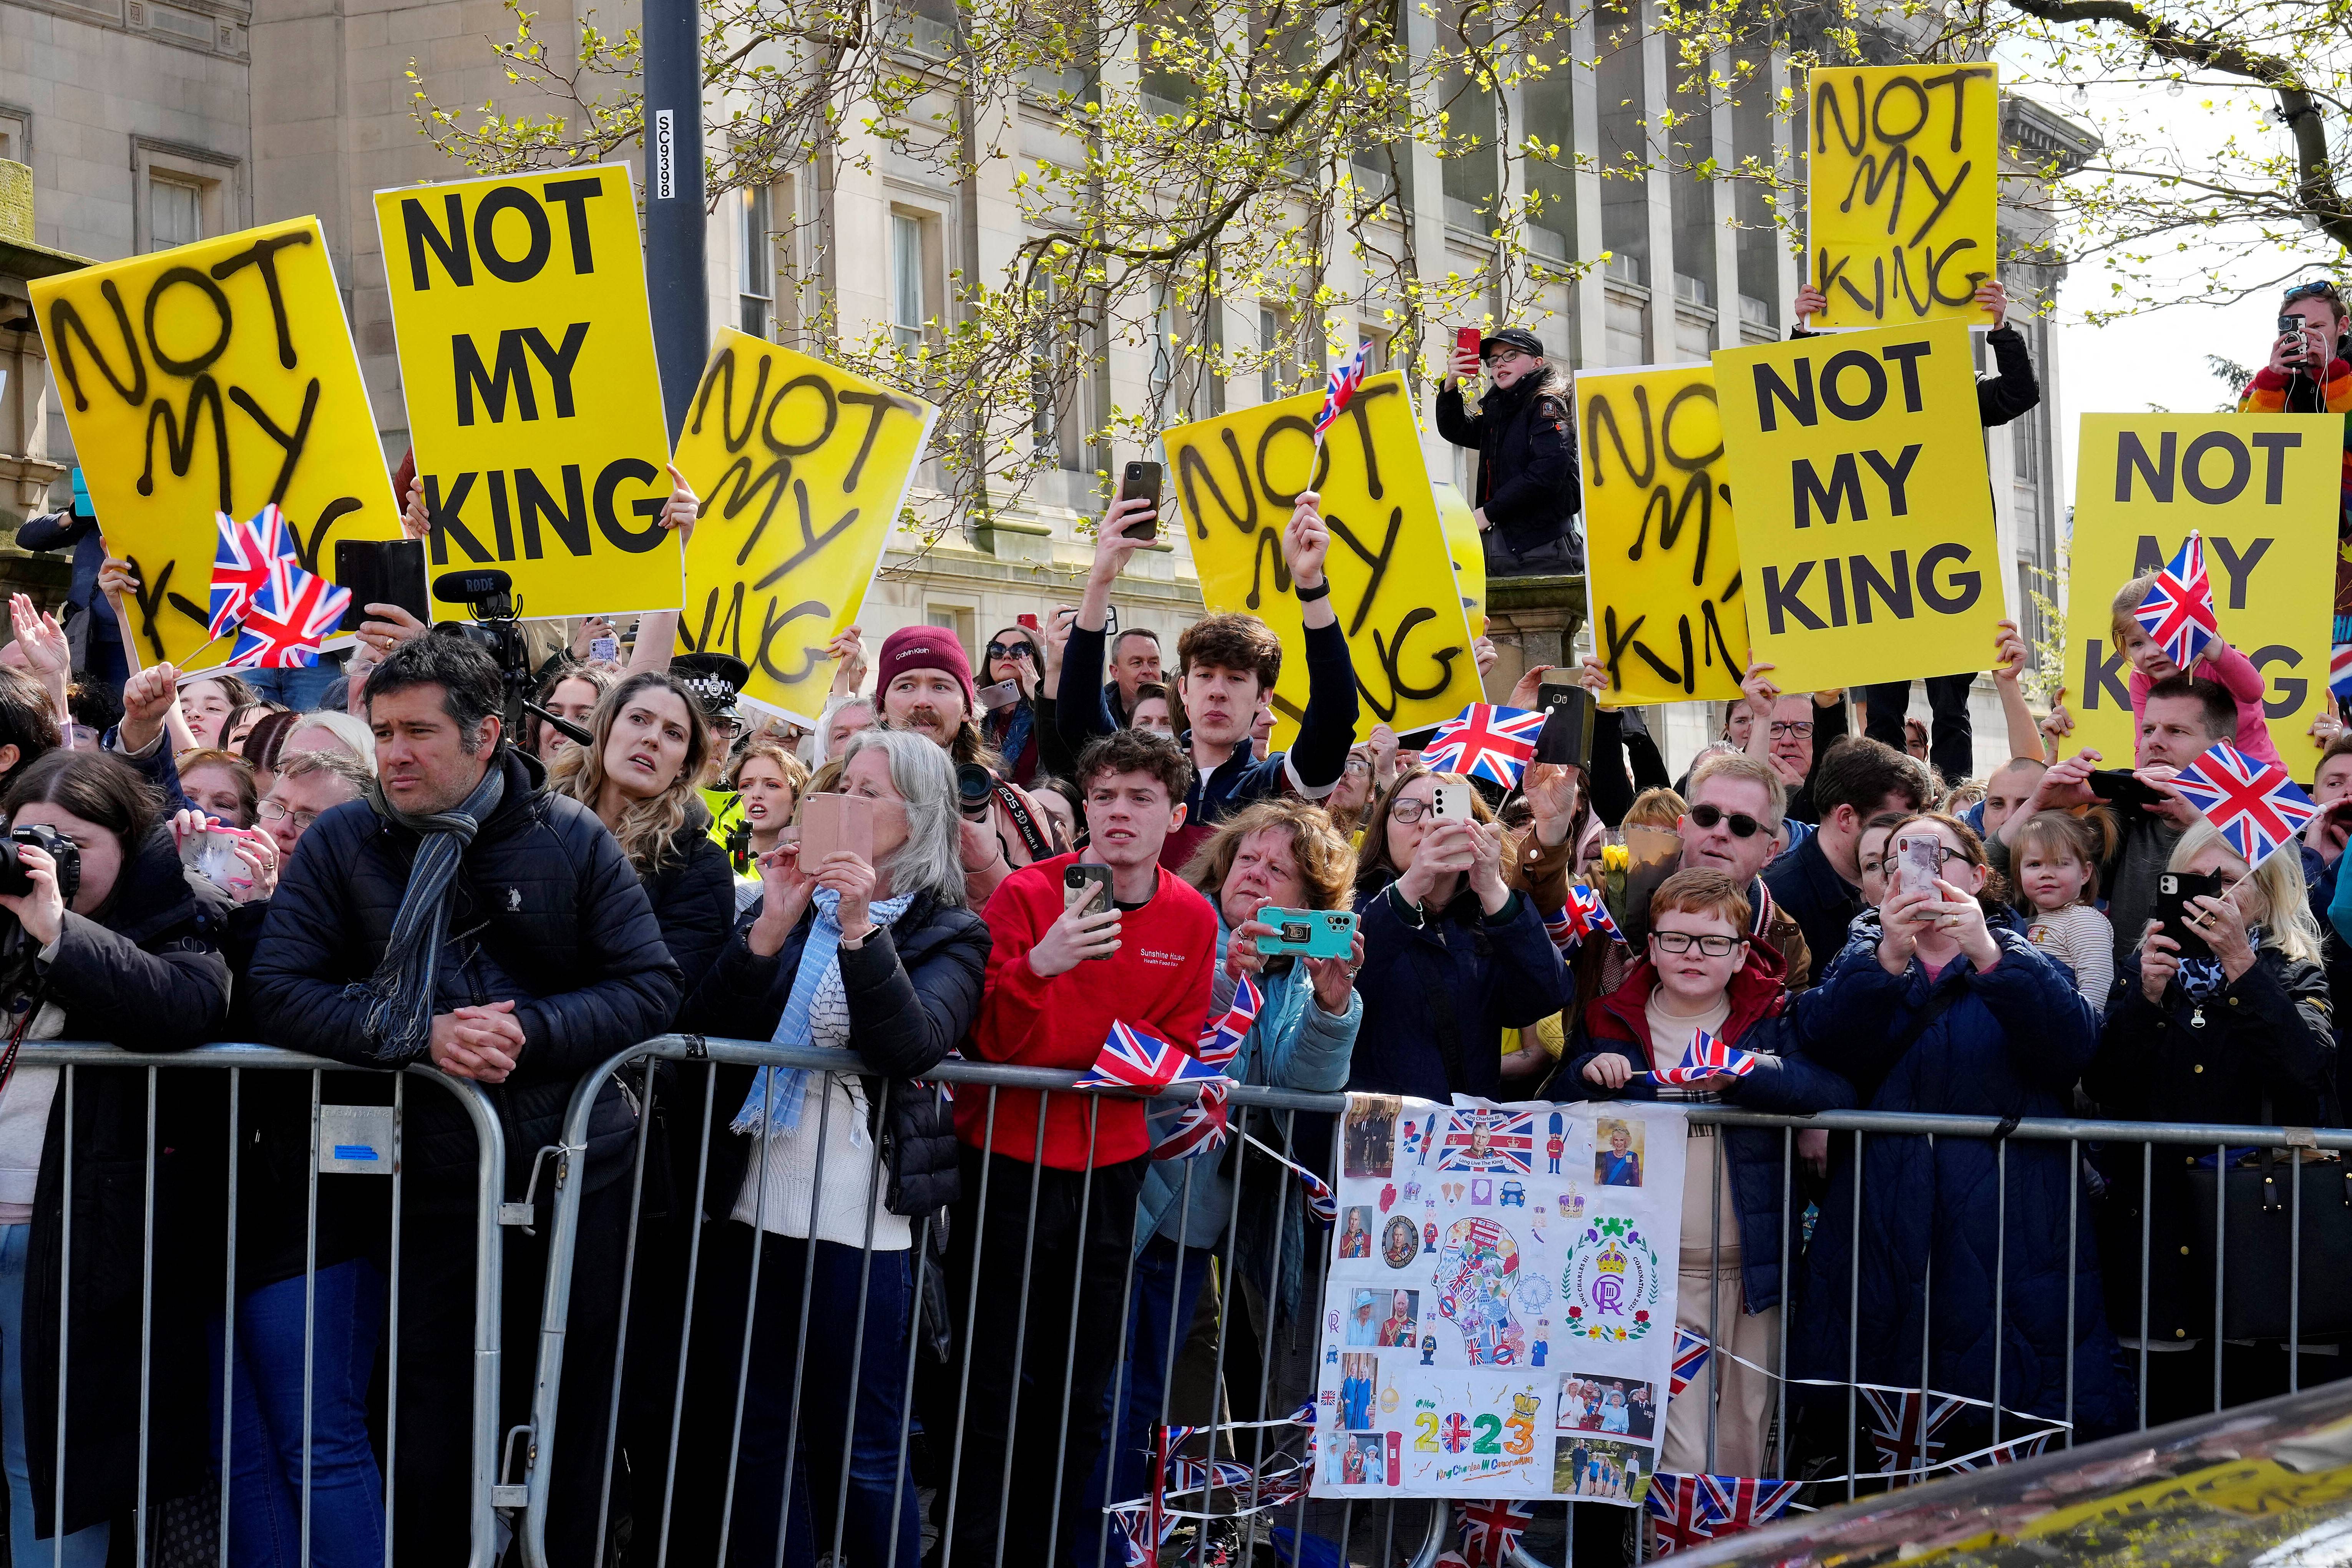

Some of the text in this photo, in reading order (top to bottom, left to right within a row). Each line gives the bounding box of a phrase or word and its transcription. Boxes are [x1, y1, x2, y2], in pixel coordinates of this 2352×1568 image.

[1816, 68, 1993, 157] NOT
[659, 116, 670, 197] SC9398
[1840, 144, 1971, 249] MY
[402, 177, 603, 291] NOT
[51, 231, 312, 413] NOT
[1819, 238, 1990, 319] KING
[451, 322, 591, 426] MY
[1752, 340, 1932, 432] NOT
[136, 372, 320, 515] MY
[692, 348, 921, 493] NOT
[1180, 382, 1399, 539] NOT
[1588, 383, 1724, 489] NO
[422, 458, 669, 565] KING
[1791, 443, 1924, 529] MY
[2115, 431, 2302, 505] NOT
[699, 456, 859, 591] MY
[1628, 468, 1742, 602] M
[466, 577, 494, 592] RØDE
[1762, 542, 1982, 635] KING
[896, 650, 914, 660] Calvin
[1604, 599, 1745, 695] KIN
[2082, 638, 2308, 720] KG
[998, 788, 1019, 809] EOS
[1015, 810, 1027, 824] 5D
[1023, 826, 1035, 845] Mark
[1140, 948, 1185, 961] Sunshine House
[1384, 1253, 1396, 1267] MAJESTY
[1405, 1245, 1417, 1263] CHARLES
[1389, 1216, 1398, 1225] SAVE
[1405, 1218, 1414, 1229] KING
[1477, 1227, 1496, 1236] LONDON
[1579, 1293, 1589, 1308] KING
[1628, 1257, 1644, 1311] CORONATION 2023
[1414, 1412, 1534, 1455] 2023
